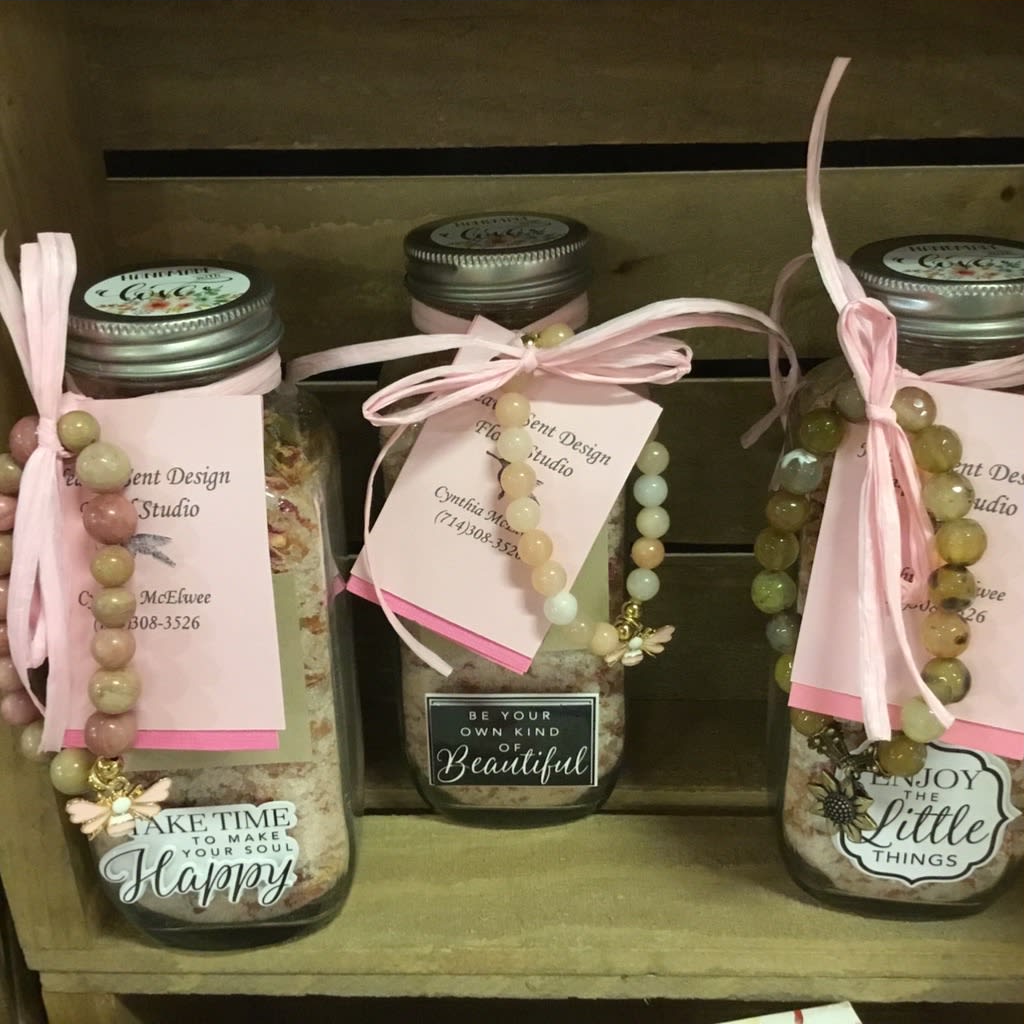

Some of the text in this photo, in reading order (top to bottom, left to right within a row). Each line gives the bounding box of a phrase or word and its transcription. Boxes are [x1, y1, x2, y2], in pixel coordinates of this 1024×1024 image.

[558, 430, 612, 466] Design
[166, 466, 231, 492] Design
[138, 497, 200, 519] Studio
[434, 485, 484, 517] Cynthia
[973, 494, 1018, 517] udio
[140, 587, 211, 605] McElwee
[468, 710, 551, 721] BE YOUR
[460, 726, 560, 737] OWN KIND
[498, 742, 521, 753] OF
[436, 744, 589, 785] Beautiful
[903, 790, 939, 802] THE
[211, 806, 292, 832] TIME
[861, 797, 990, 849] Little
[192, 830, 281, 846] TO MAKE
[182, 844, 294, 858] YOUR SOUL
[872, 849, 958, 867] THINGS
[103, 847, 295, 907] Happy
